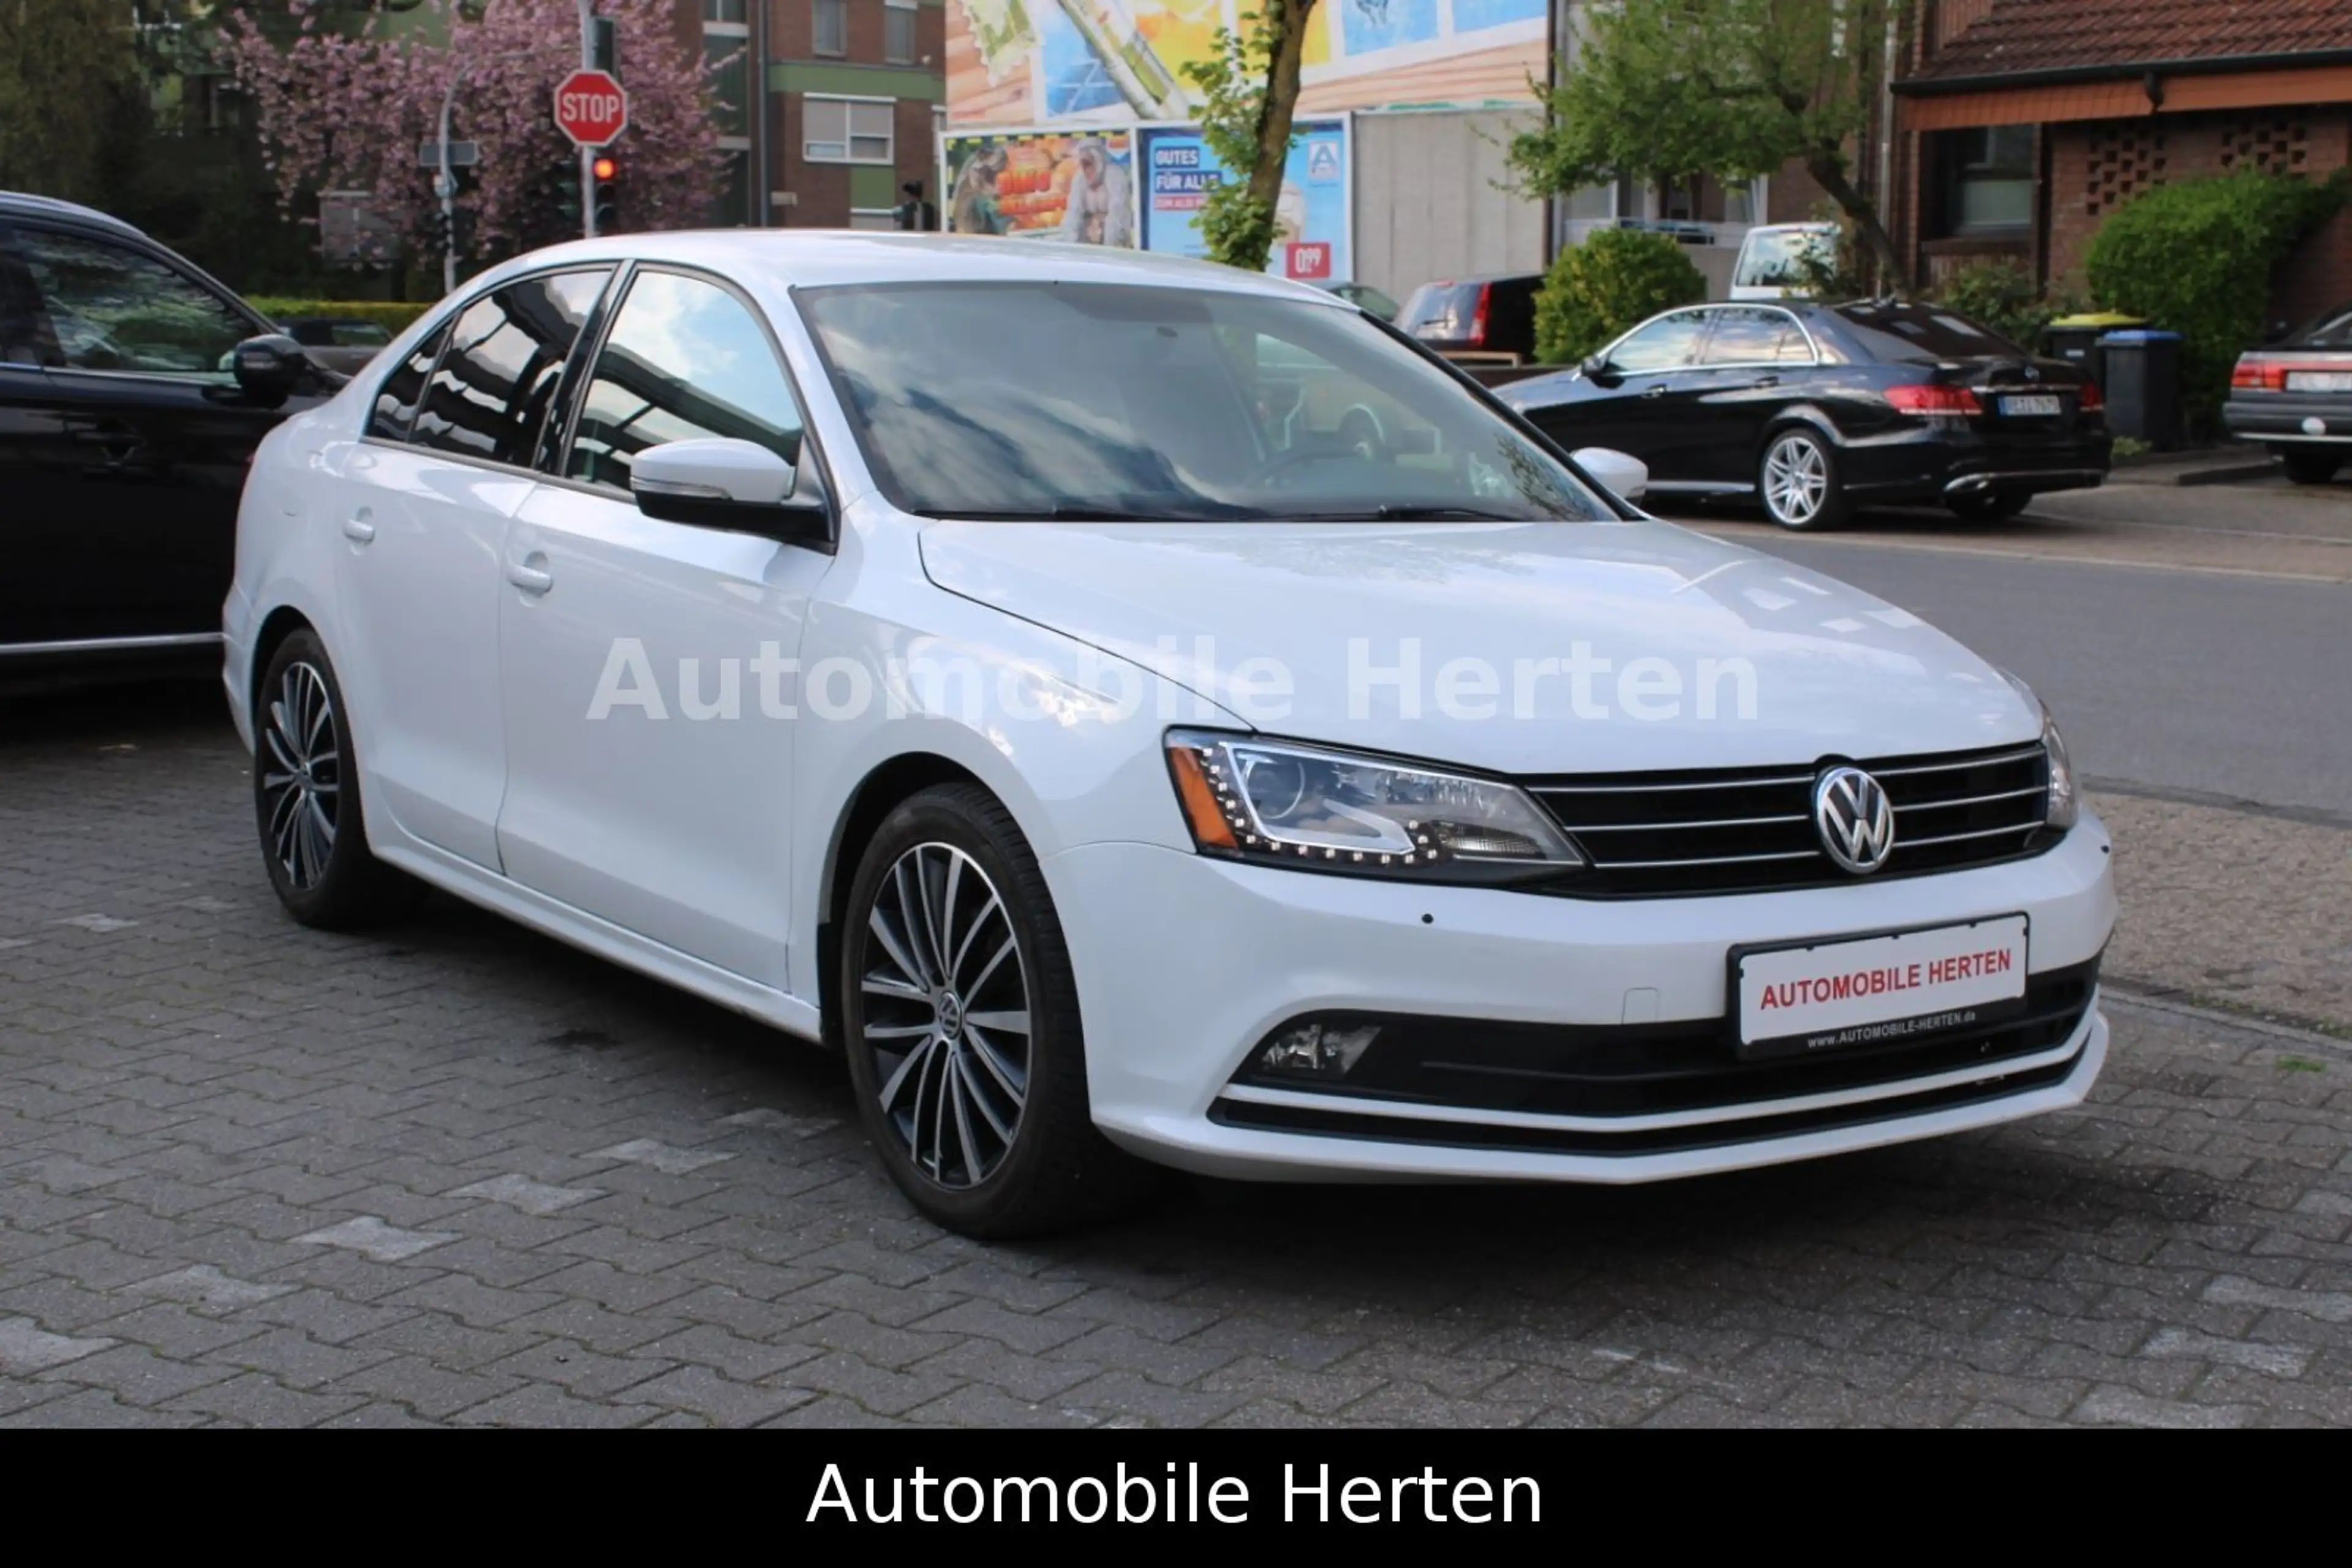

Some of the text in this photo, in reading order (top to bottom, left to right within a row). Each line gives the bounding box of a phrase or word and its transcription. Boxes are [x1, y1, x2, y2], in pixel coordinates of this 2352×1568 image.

[562, 92, 620, 123] STOP
[1155, 149, 1198, 166] GUTES
[1155, 171, 1182, 190] FÜR
[1760, 949, 2011, 1010] AUTOMOBILE HERTEN
[1807, 1011, 1976, 1047] www.AUTOMOBILE-HERTEN.de
